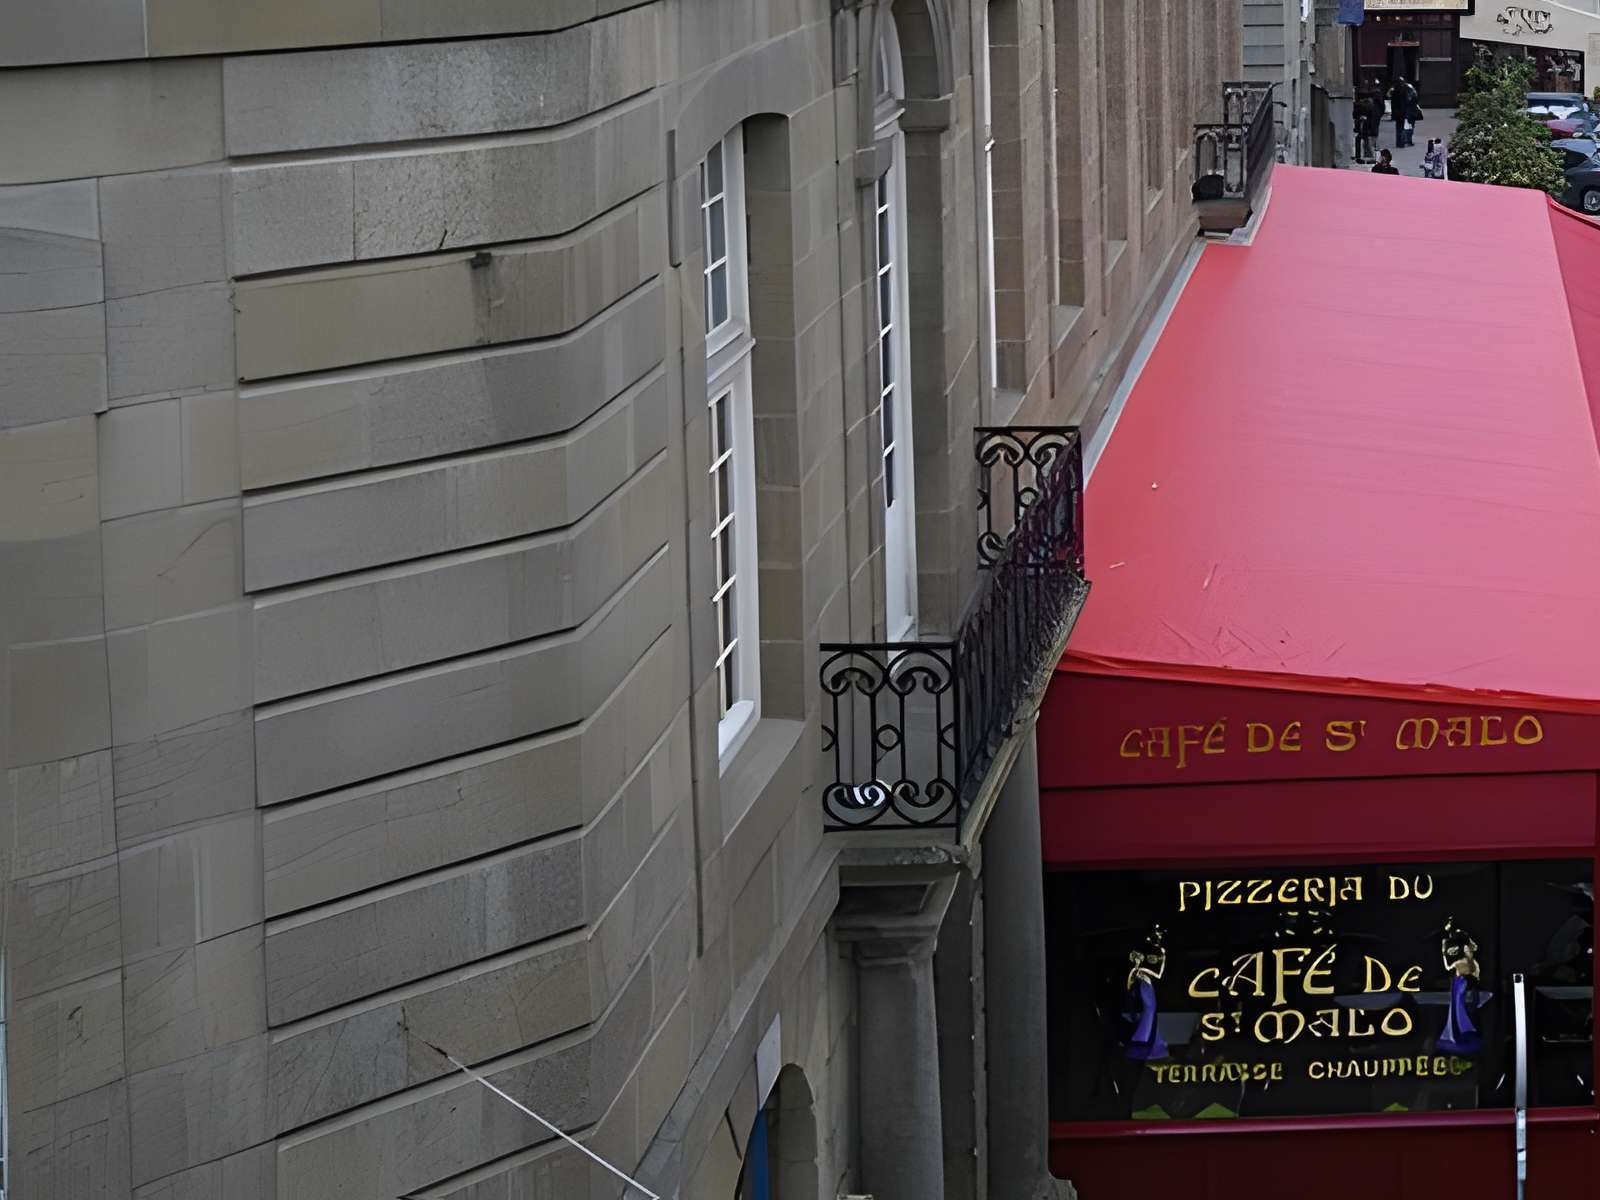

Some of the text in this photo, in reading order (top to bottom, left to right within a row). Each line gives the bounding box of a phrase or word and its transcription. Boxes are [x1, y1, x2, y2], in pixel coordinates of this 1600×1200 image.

[1247, 721, 1302, 754] DE
[1395, 715, 1544, 751] MALO
[1178, 874, 1434, 912] PIZZERIA DU
[1362, 955, 1423, 994] DE
[1253, 1006, 1413, 1044] MALO
